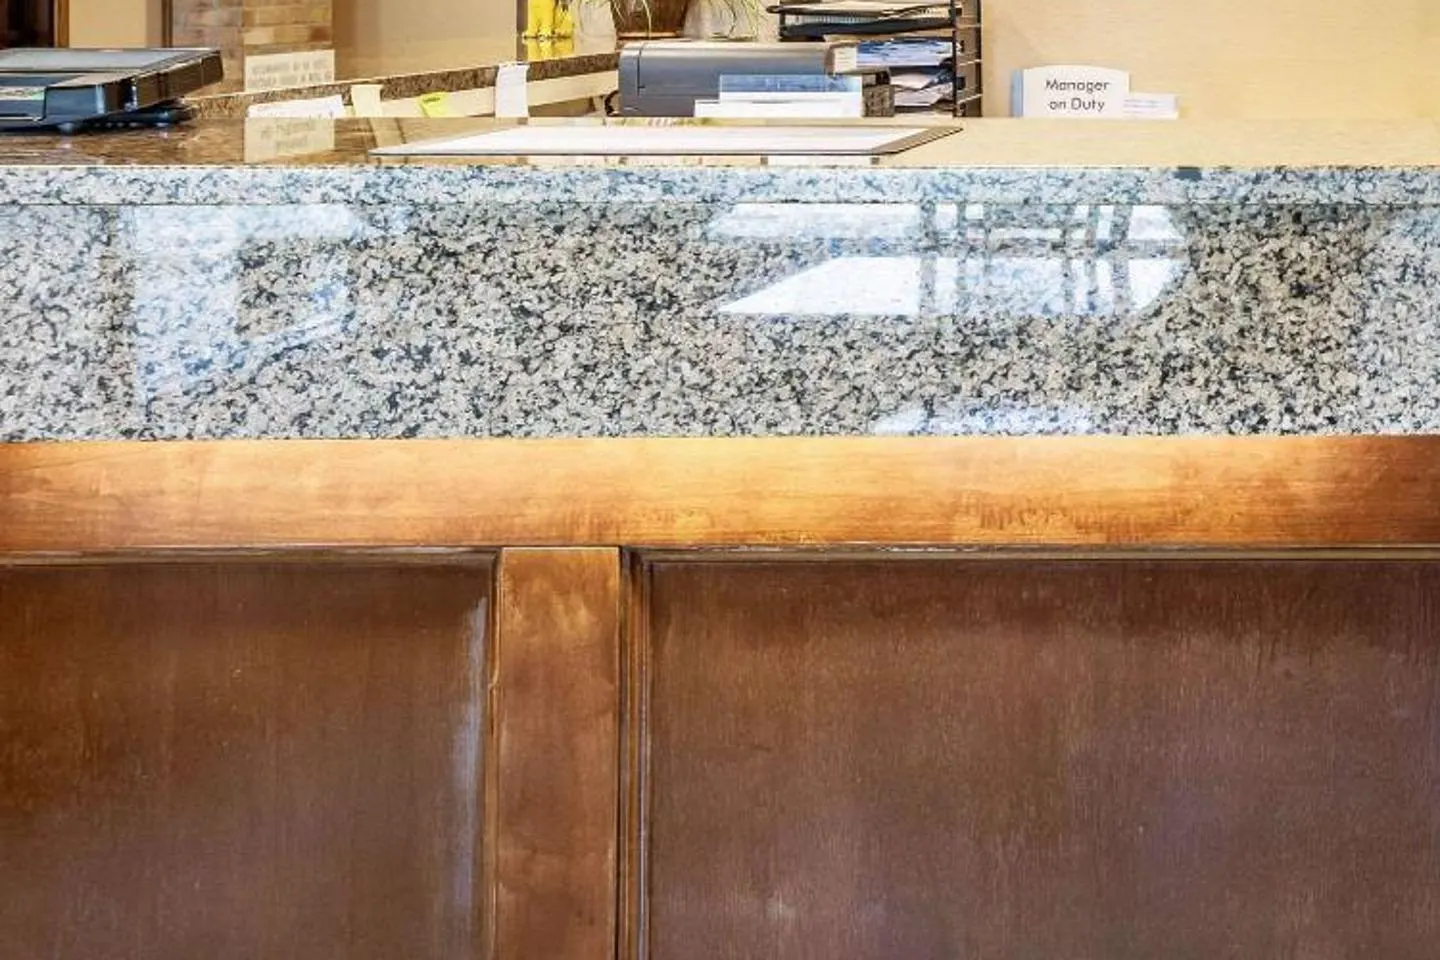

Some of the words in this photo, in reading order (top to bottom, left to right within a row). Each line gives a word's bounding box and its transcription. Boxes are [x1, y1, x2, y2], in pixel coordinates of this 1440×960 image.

[1045, 78, 1111, 94] Manager
[1049, 100, 1067, 111] on
[1070, 97, 1105, 112] Duty
